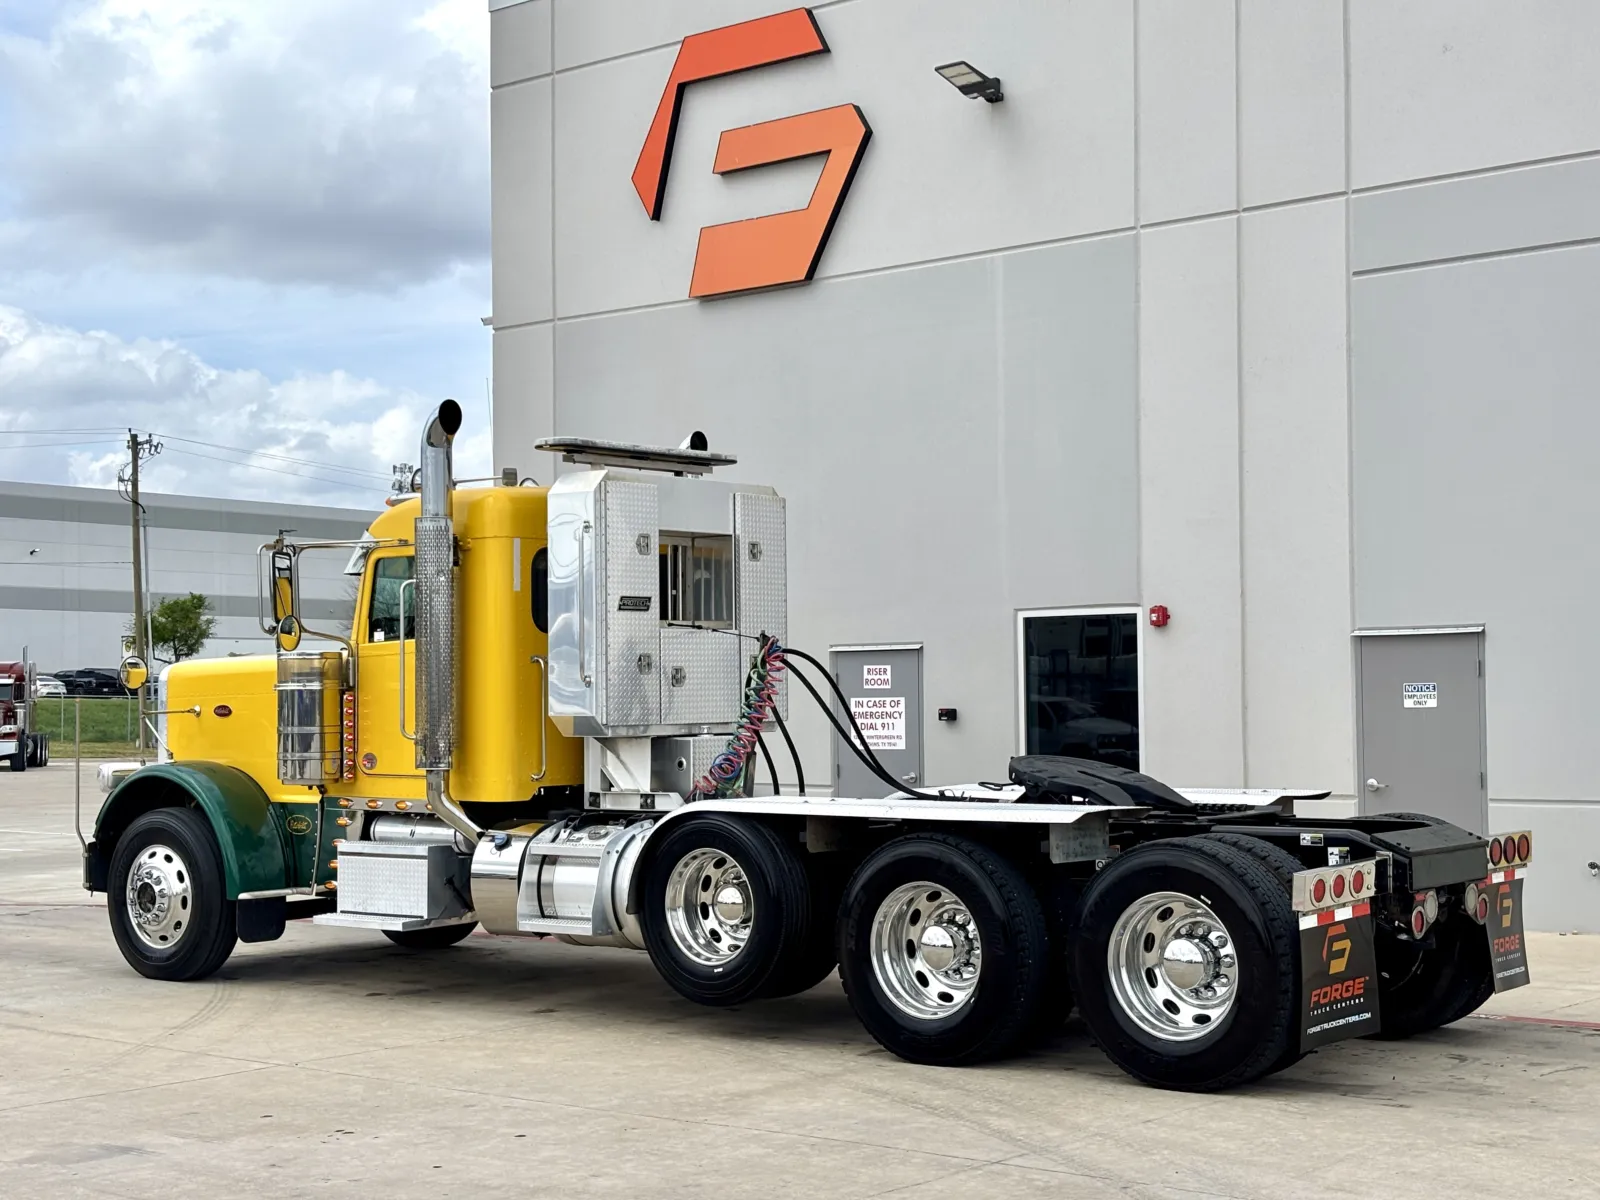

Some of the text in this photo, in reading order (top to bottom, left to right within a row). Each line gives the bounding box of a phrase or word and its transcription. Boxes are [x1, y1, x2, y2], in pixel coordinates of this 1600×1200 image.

[866, 667, 888, 676] RISER
[864, 678, 890, 686] ROOM
[1405, 684, 1435, 692] NOTICE
[854, 699, 901, 708] IN CASE OF
[853, 711, 903, 719] EMERGENCY
[860, 722, 895, 731] DIAL 911
[1494, 934, 1520, 953] FORGE
[1310, 977, 1365, 1008] FORGE
[1310, 997, 1364, 1017] TRUCK CENTERS
[1306, 1012, 1372, 1035] FORGETRUCKCENTERS.COM
